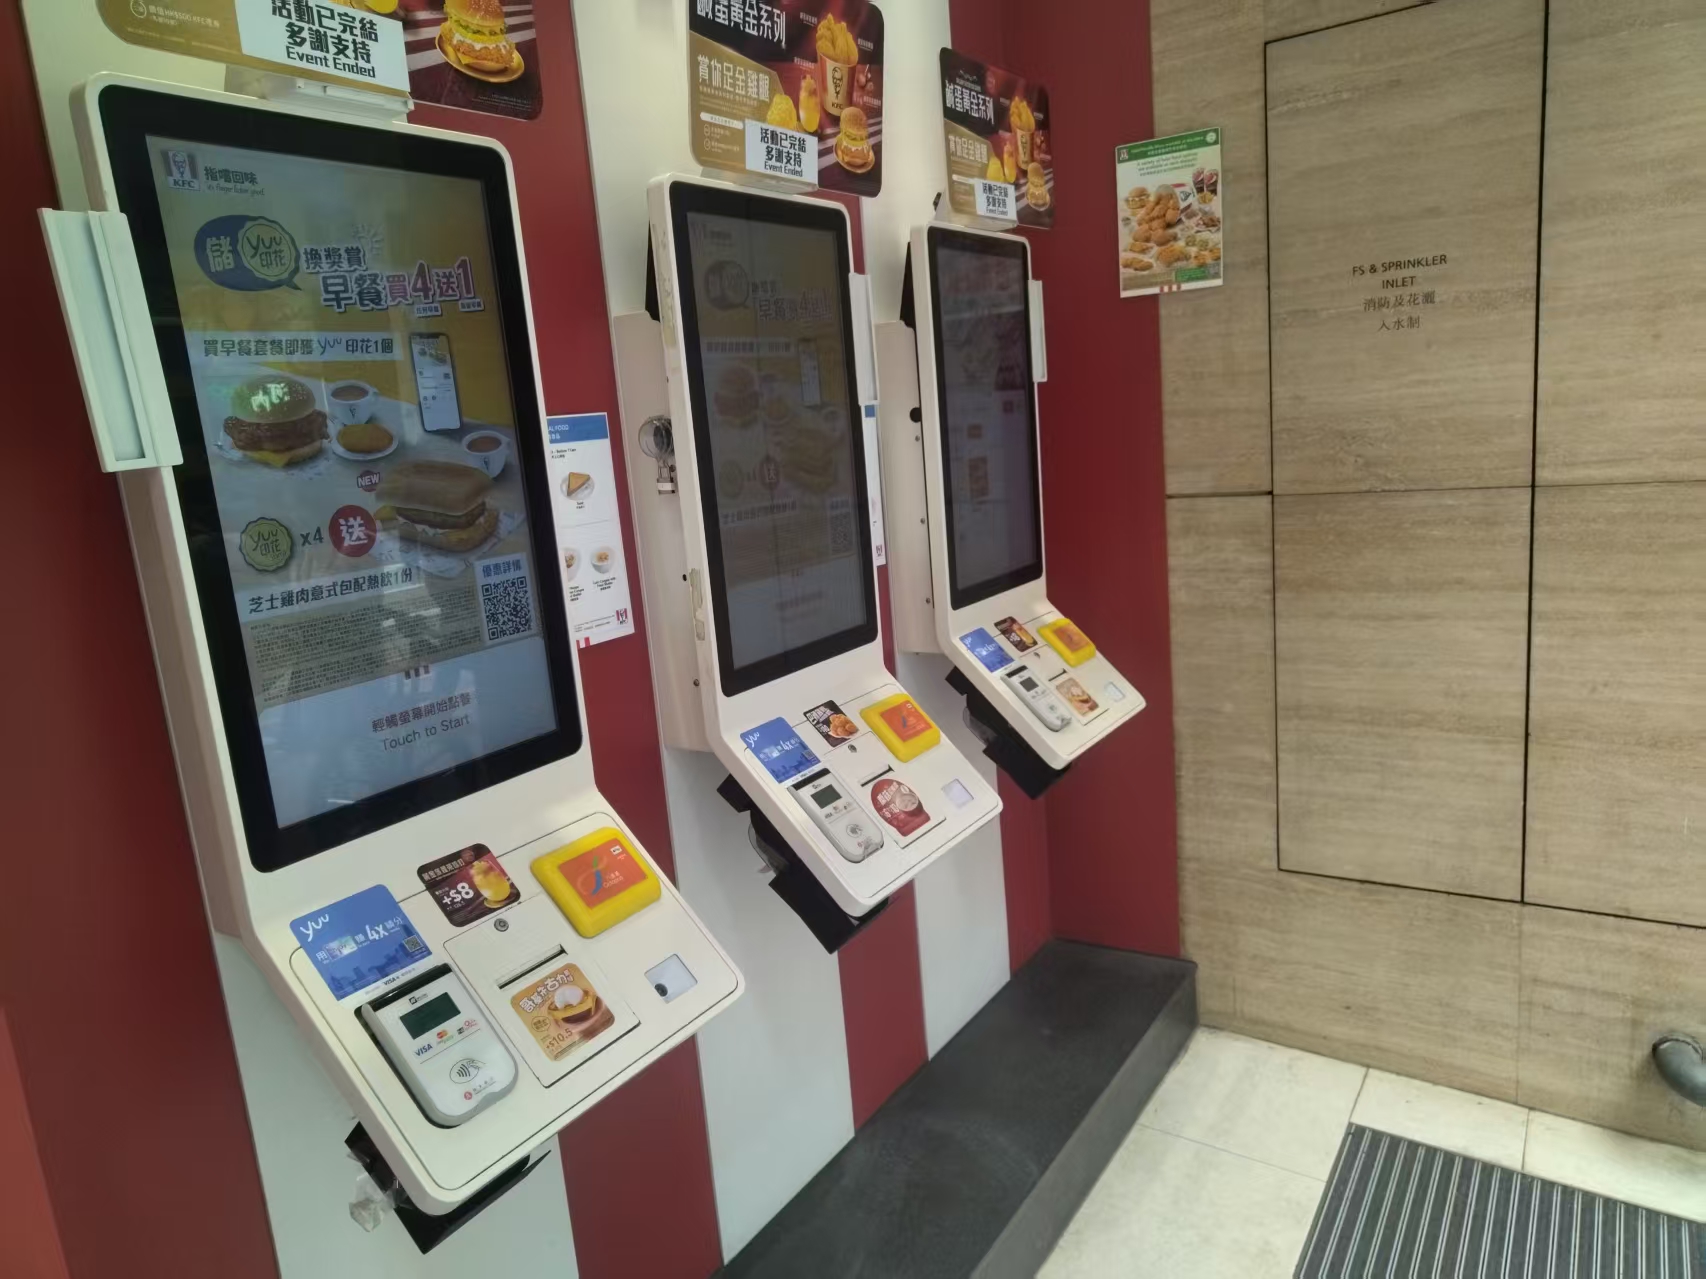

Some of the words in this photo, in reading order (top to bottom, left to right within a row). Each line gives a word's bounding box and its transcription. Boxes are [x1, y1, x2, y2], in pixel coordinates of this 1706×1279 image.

[271, 0, 379, 42] 活動已完結
[285, 21, 371, 64] 多謝支持
[286, 45, 330, 68] Event
[333, 57, 376, 78] Ended
[760, 127, 807, 153] 活動已完結
[765, 145, 802, 168] 多謝支持
[764, 161, 782, 173] Event
[783, 165, 803, 178] Ended
[172, 178, 195, 189] KFC
[246, 234, 282, 258] yuu
[259, 250, 287, 269] 印花
[1352, 265, 1365, 276] FS
[1369, 263, 1377, 274] &
[1381, 254, 1447, 273] SPRINKLER
[1382, 276, 1416, 289] INLET
[357, 472, 381, 487] NEW
[249, 528, 279, 552] yuu
[339, 517, 369, 547] 送
[260, 538, 281, 556] 印花
[248, 567, 413, 615] 芝士雞肉意式包配熱飲1份
[383, 730, 421, 752] Touch
[425, 725, 437, 737] to
[440, 714, 471, 732] Start
[746, 731, 760, 748] yuu
[300, 914, 329, 942] yuu
[415, 1043, 433, 1057] VISA
